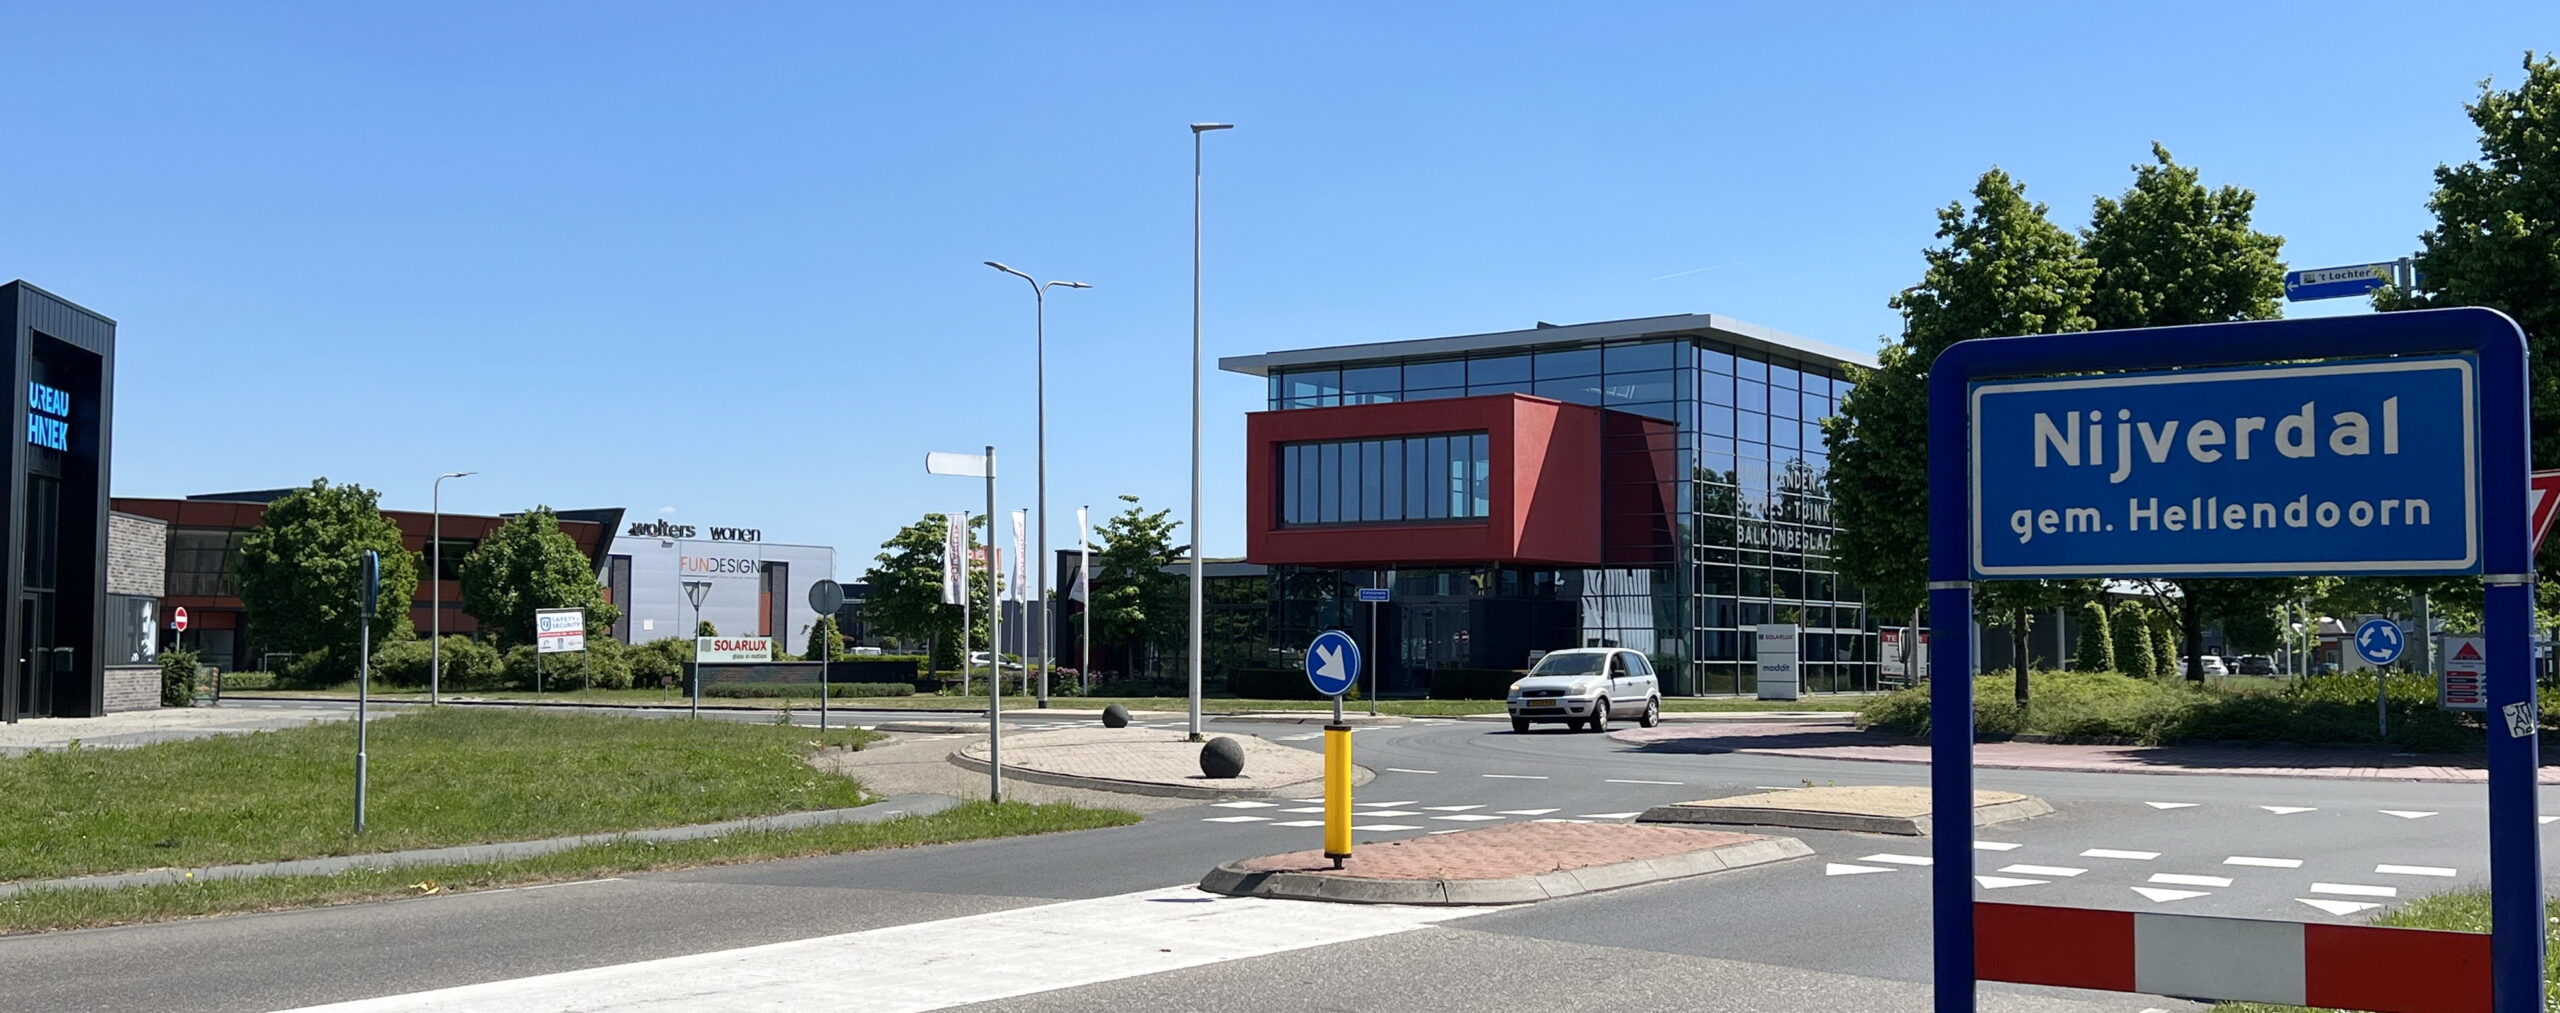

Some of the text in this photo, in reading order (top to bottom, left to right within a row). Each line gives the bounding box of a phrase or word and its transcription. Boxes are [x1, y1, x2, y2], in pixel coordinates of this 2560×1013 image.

[2318, 269, 2372, 281] 't Lochter
[2034, 396, 2399, 484] Nijverdal
[630, 518, 761, 542] wolters wonen
[2010, 495, 2431, 545] gem. Hellendoorn
[1737, 525, 1839, 551] BALKONBEGLAZ
[714, 640, 767, 652] SOLARLUX
